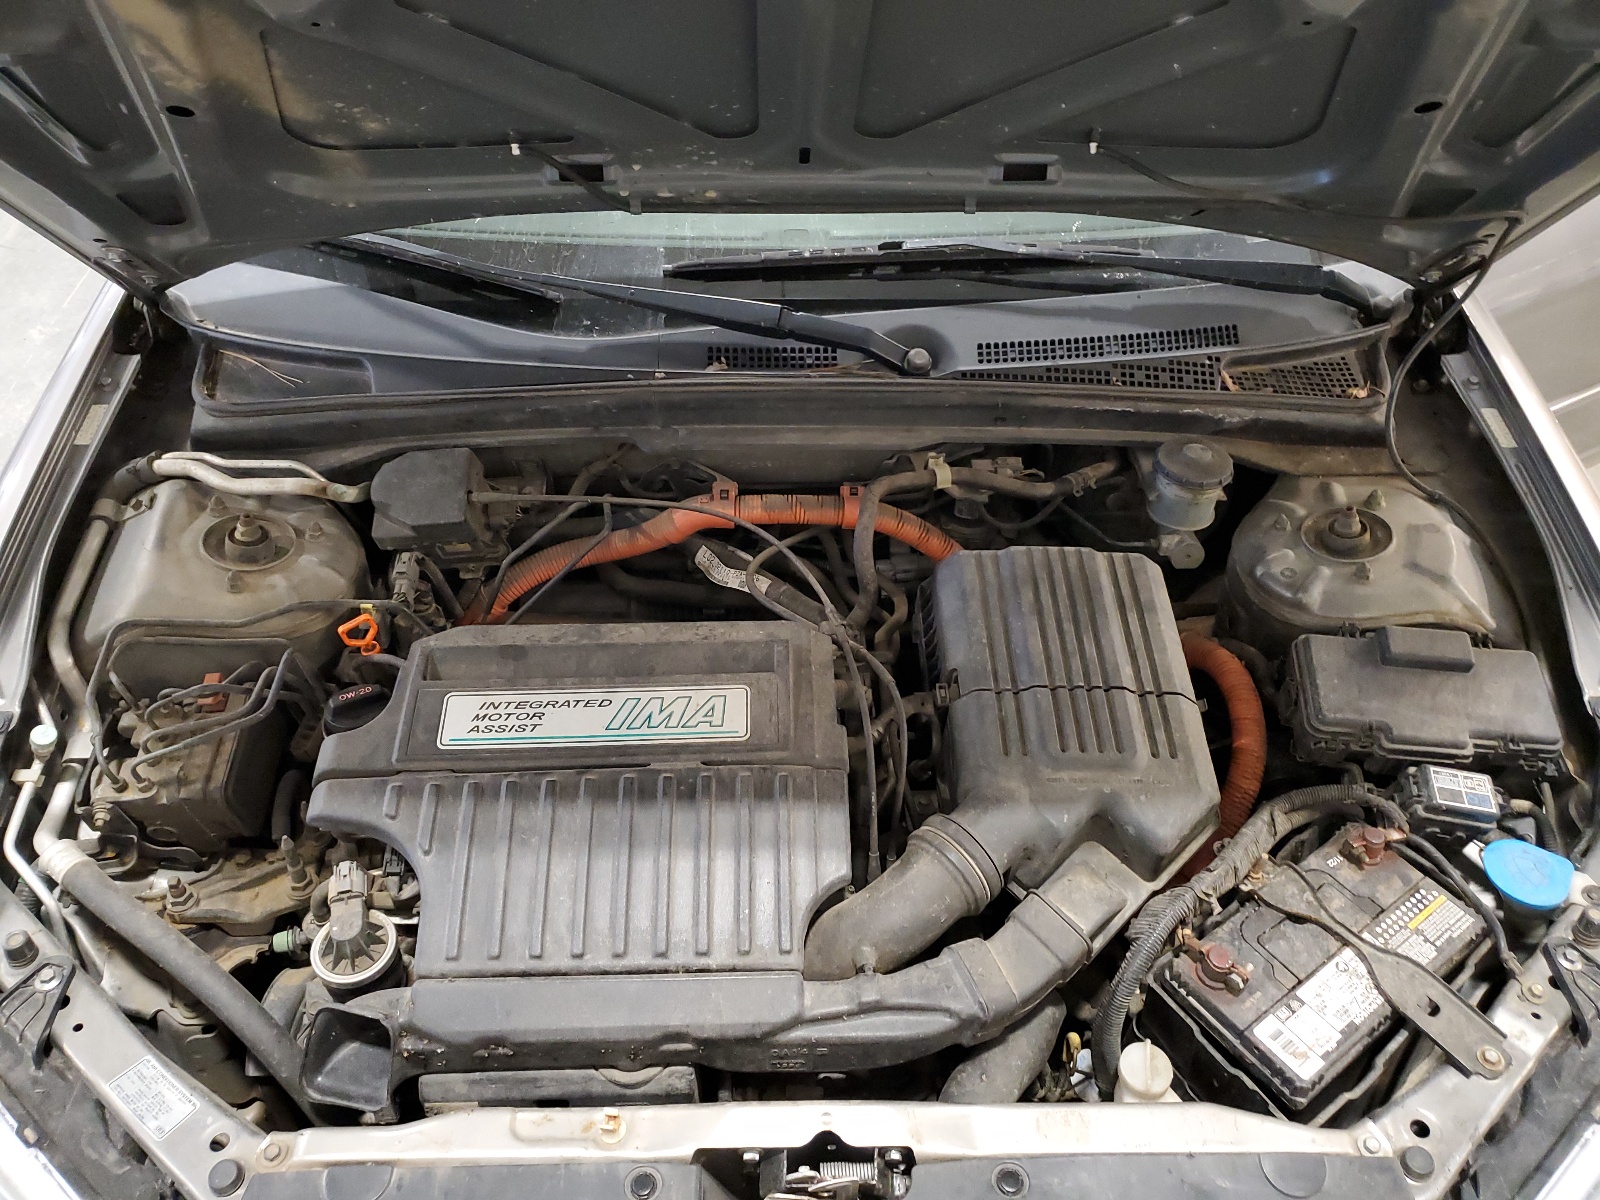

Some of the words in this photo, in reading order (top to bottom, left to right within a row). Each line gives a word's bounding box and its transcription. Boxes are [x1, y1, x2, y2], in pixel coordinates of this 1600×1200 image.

[478, 698, 613, 711] INTEGRATED
[471, 711, 546, 723] MOTOR
[605, 694, 727, 731] IMA
[466, 723, 543, 734] ASSIST
